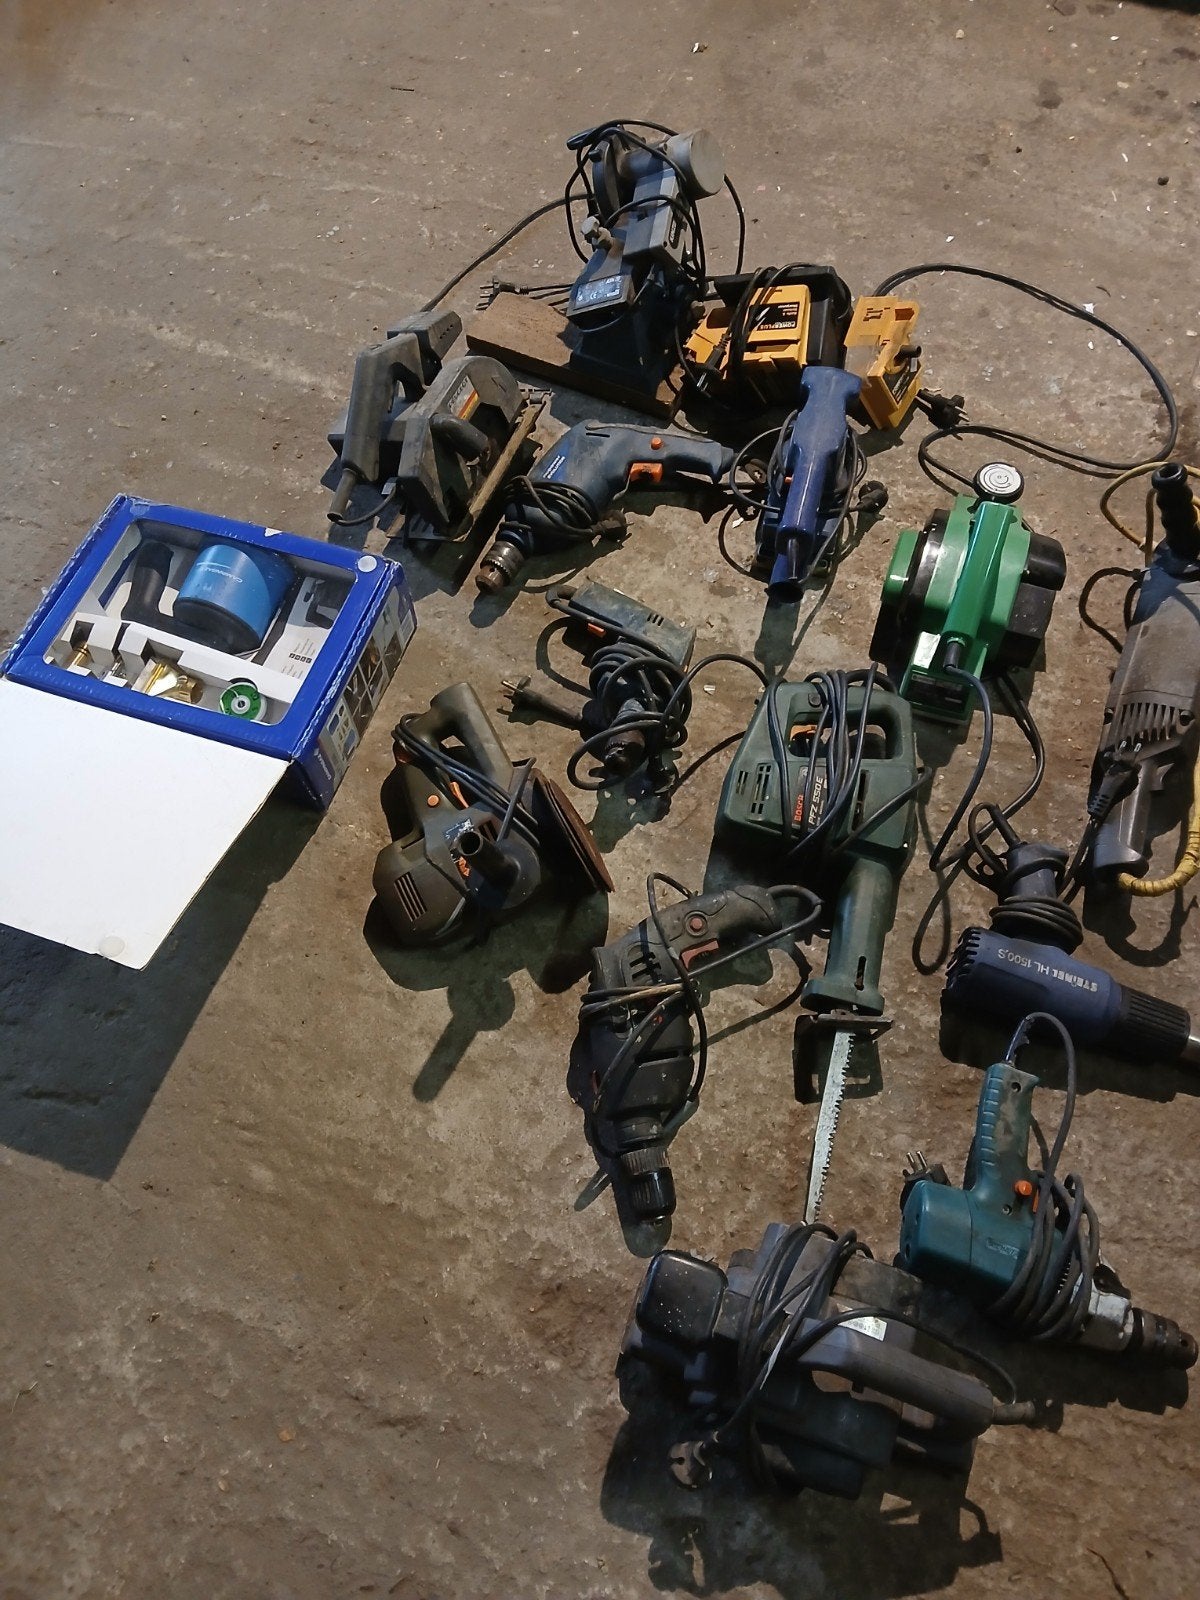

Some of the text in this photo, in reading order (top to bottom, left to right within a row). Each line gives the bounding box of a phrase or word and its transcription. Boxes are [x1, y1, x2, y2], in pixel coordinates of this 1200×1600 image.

[449, 378, 468, 408] PEUGEOT
[795, 794, 804, 821] BOSCH
[808, 804, 818, 825] PFZ
[1034, 961, 1049, 975] HL
